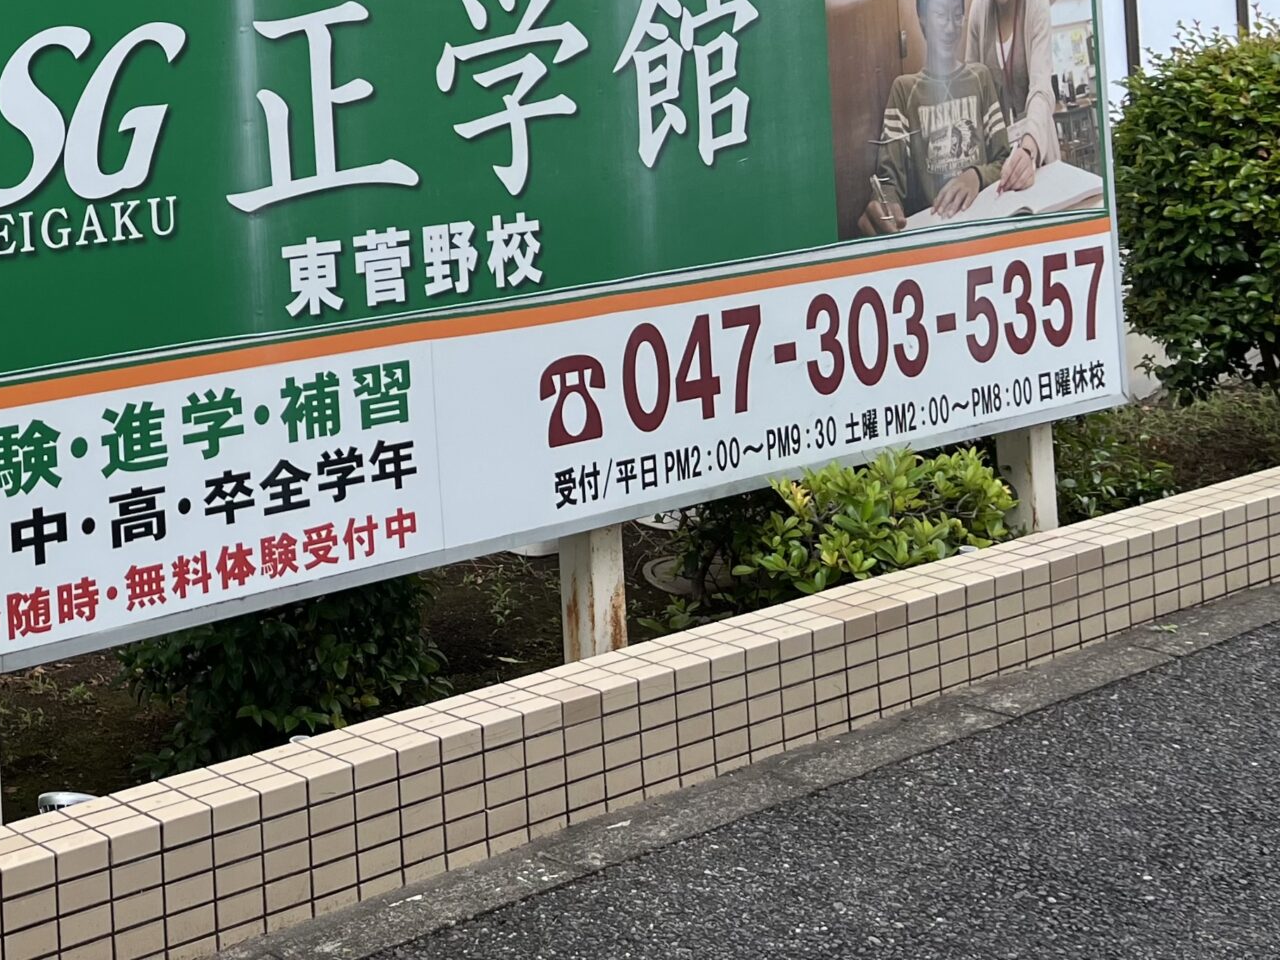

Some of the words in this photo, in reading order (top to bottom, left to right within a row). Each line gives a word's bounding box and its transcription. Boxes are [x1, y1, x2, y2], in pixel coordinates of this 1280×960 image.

[282, 213, 547, 318] 東菅野校
[622, 245, 1105, 434] 047-303-5357
[845, 411, 881, 445] 土曜
[1038, 360, 1107, 403] 日曜休校
